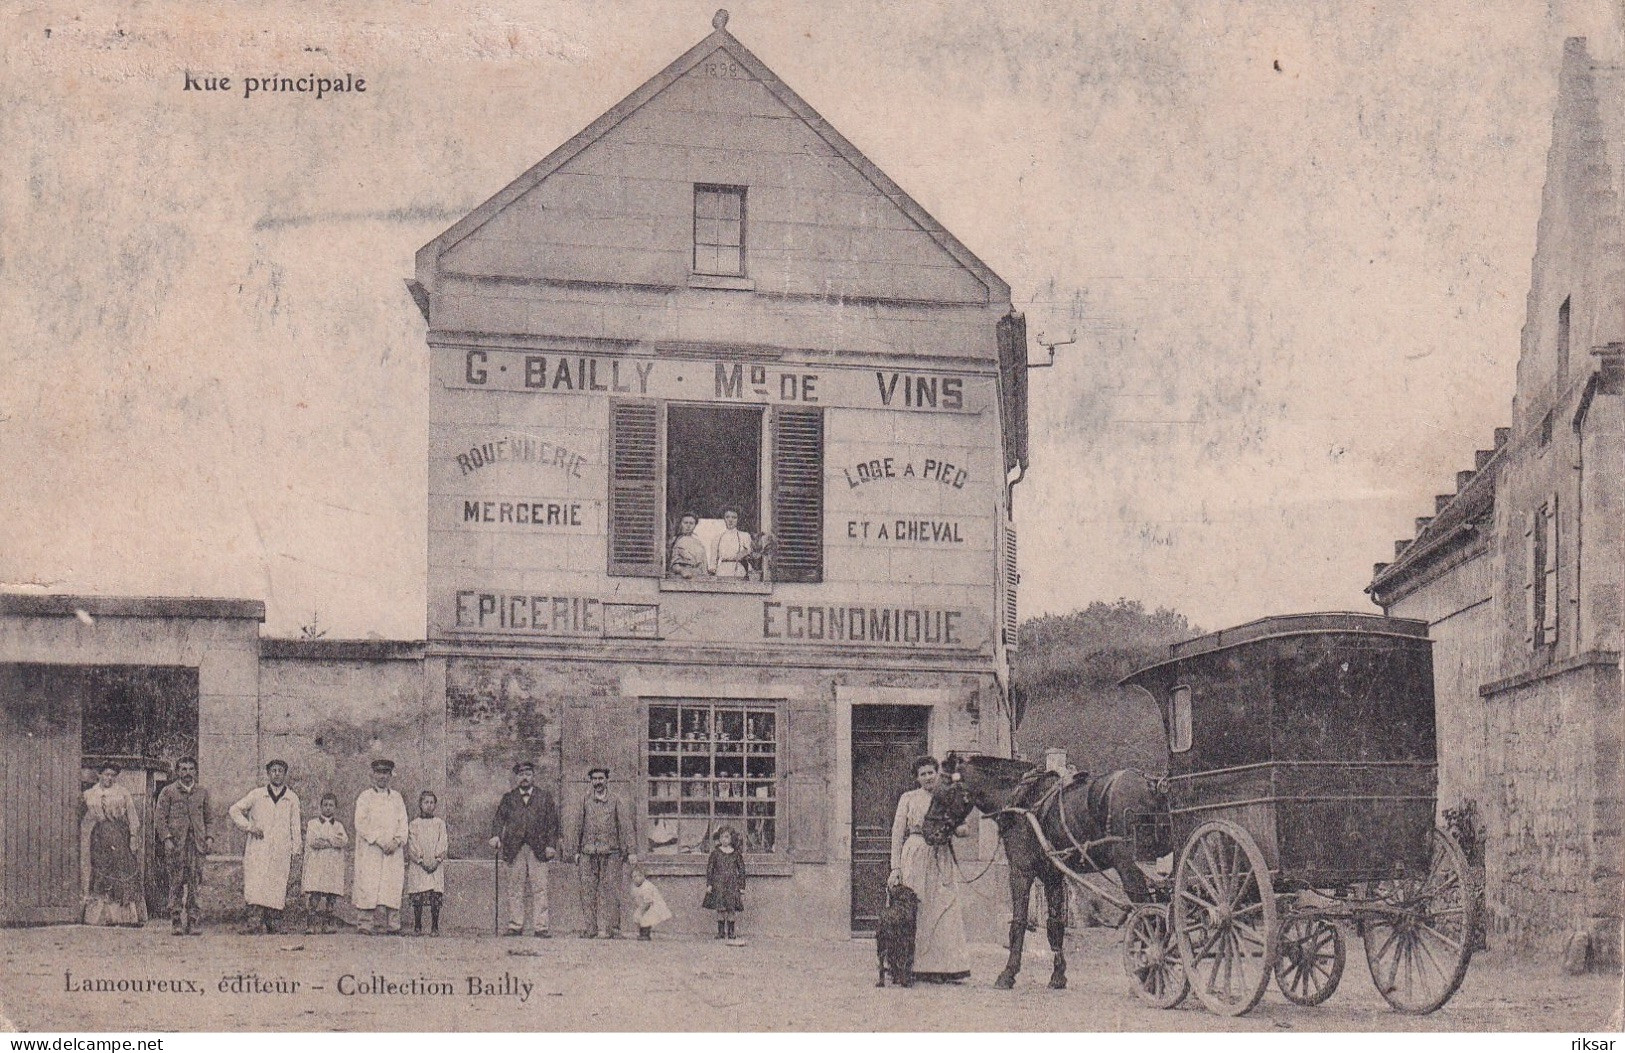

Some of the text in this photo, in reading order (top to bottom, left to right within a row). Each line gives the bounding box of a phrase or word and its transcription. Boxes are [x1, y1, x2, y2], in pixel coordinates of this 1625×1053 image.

[524, 356, 653, 393] BAILLY
[780, 374, 818, 401] DE
[876, 372, 963, 409] VINS
[456, 439, 587, 478] ROUENNERIE
[843, 457, 896, 489] LOGE
[904, 463, 915, 477] A
[464, 500, 581, 526] MERCERIE
[848, 520, 963, 542] ET A CHEVAL
[456, 590, 600, 632] EPICERIE
[763, 601, 961, 646] ECONOMIQUE
